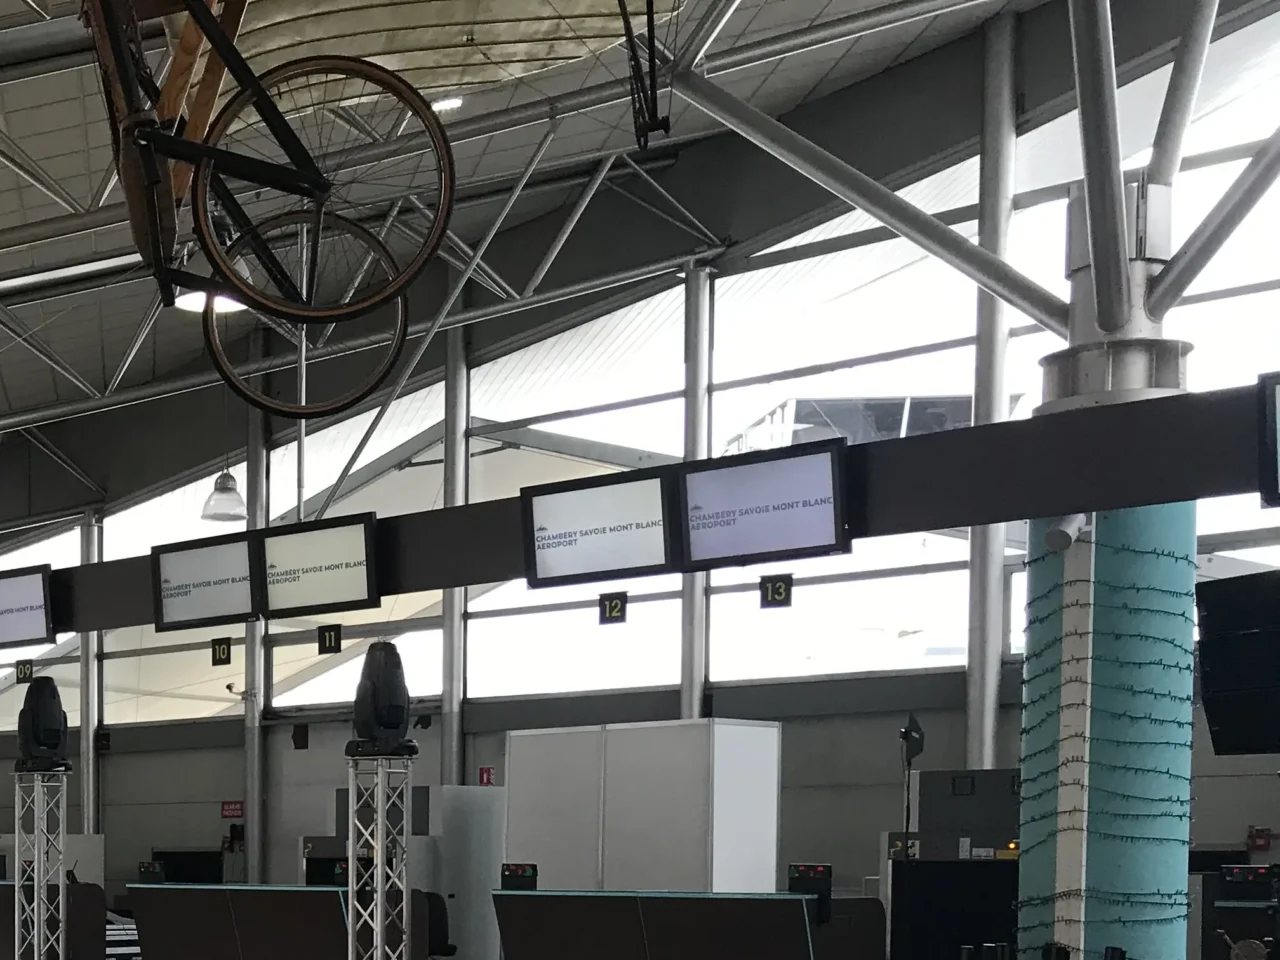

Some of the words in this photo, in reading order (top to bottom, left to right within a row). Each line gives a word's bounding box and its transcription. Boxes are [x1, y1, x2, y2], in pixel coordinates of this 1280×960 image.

[690, 509, 737, 523] CHAMBERY
[772, 501, 800, 512] MONT
[802, 496, 833, 508] BLANC
[535, 530, 578, 543] CHAMBERY
[609, 523, 634, 533] MONT
[635, 519, 663, 530] BLANC
[690, 518, 737, 531] AEROPORT
[536, 538, 578, 551] AEROPORT
[267, 568, 300, 579] CHAMBERY
[324, 562, 343, 571] MONT
[344, 559, 367, 569] BLANC
[267, 575, 300, 586] AEROPORT
[766, 581, 786, 601] 13
[604, 599, 622, 617] 12
[324, 631, 335, 647] 11
[215, 644, 227, 659] 10
[17, 664, 31, 678] 09
